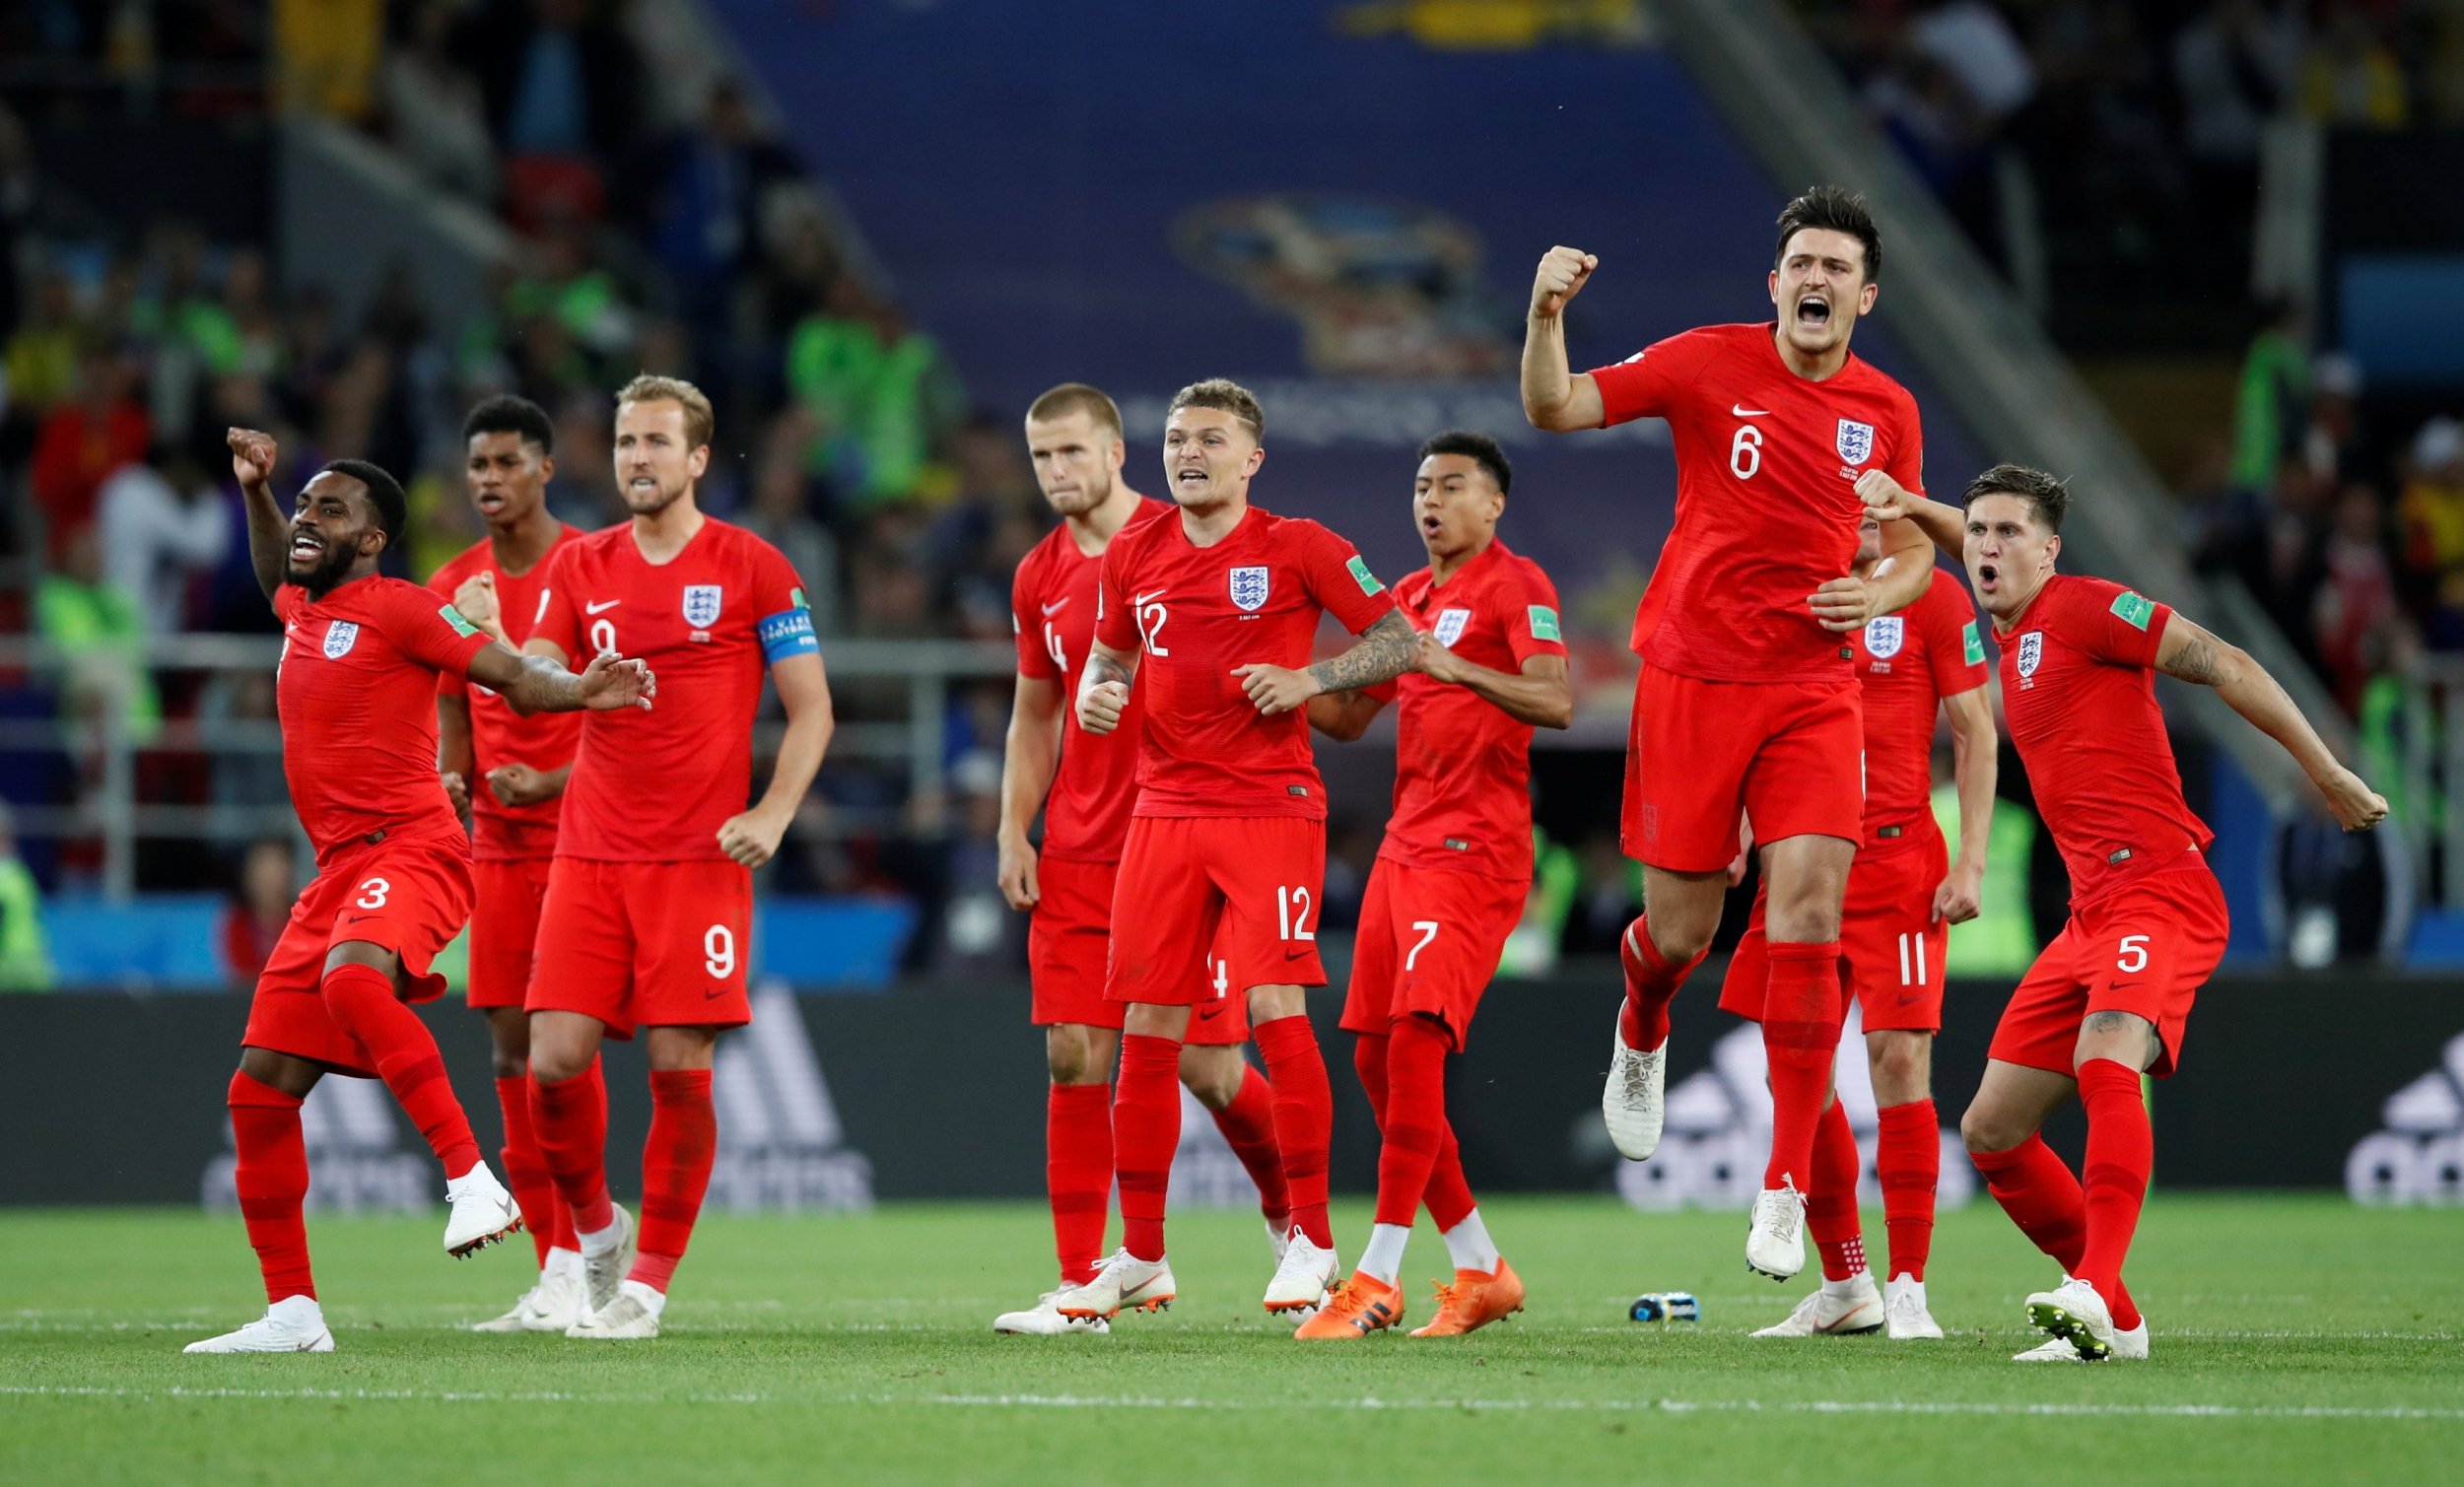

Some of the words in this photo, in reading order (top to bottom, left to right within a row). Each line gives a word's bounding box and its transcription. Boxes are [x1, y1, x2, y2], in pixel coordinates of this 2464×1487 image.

[1731, 426, 1763, 480] 6
[1044, 621, 1068, 672] 4
[1134, 602, 1169, 657] 12
[356, 877, 390, 910] 3
[1277, 885, 1315, 941] 12
[704, 923, 735, 980] 9
[1404, 920, 1439, 972] 7
[1898, 931, 1927, 986] 11
[2116, 934, 2151, 974] 5
